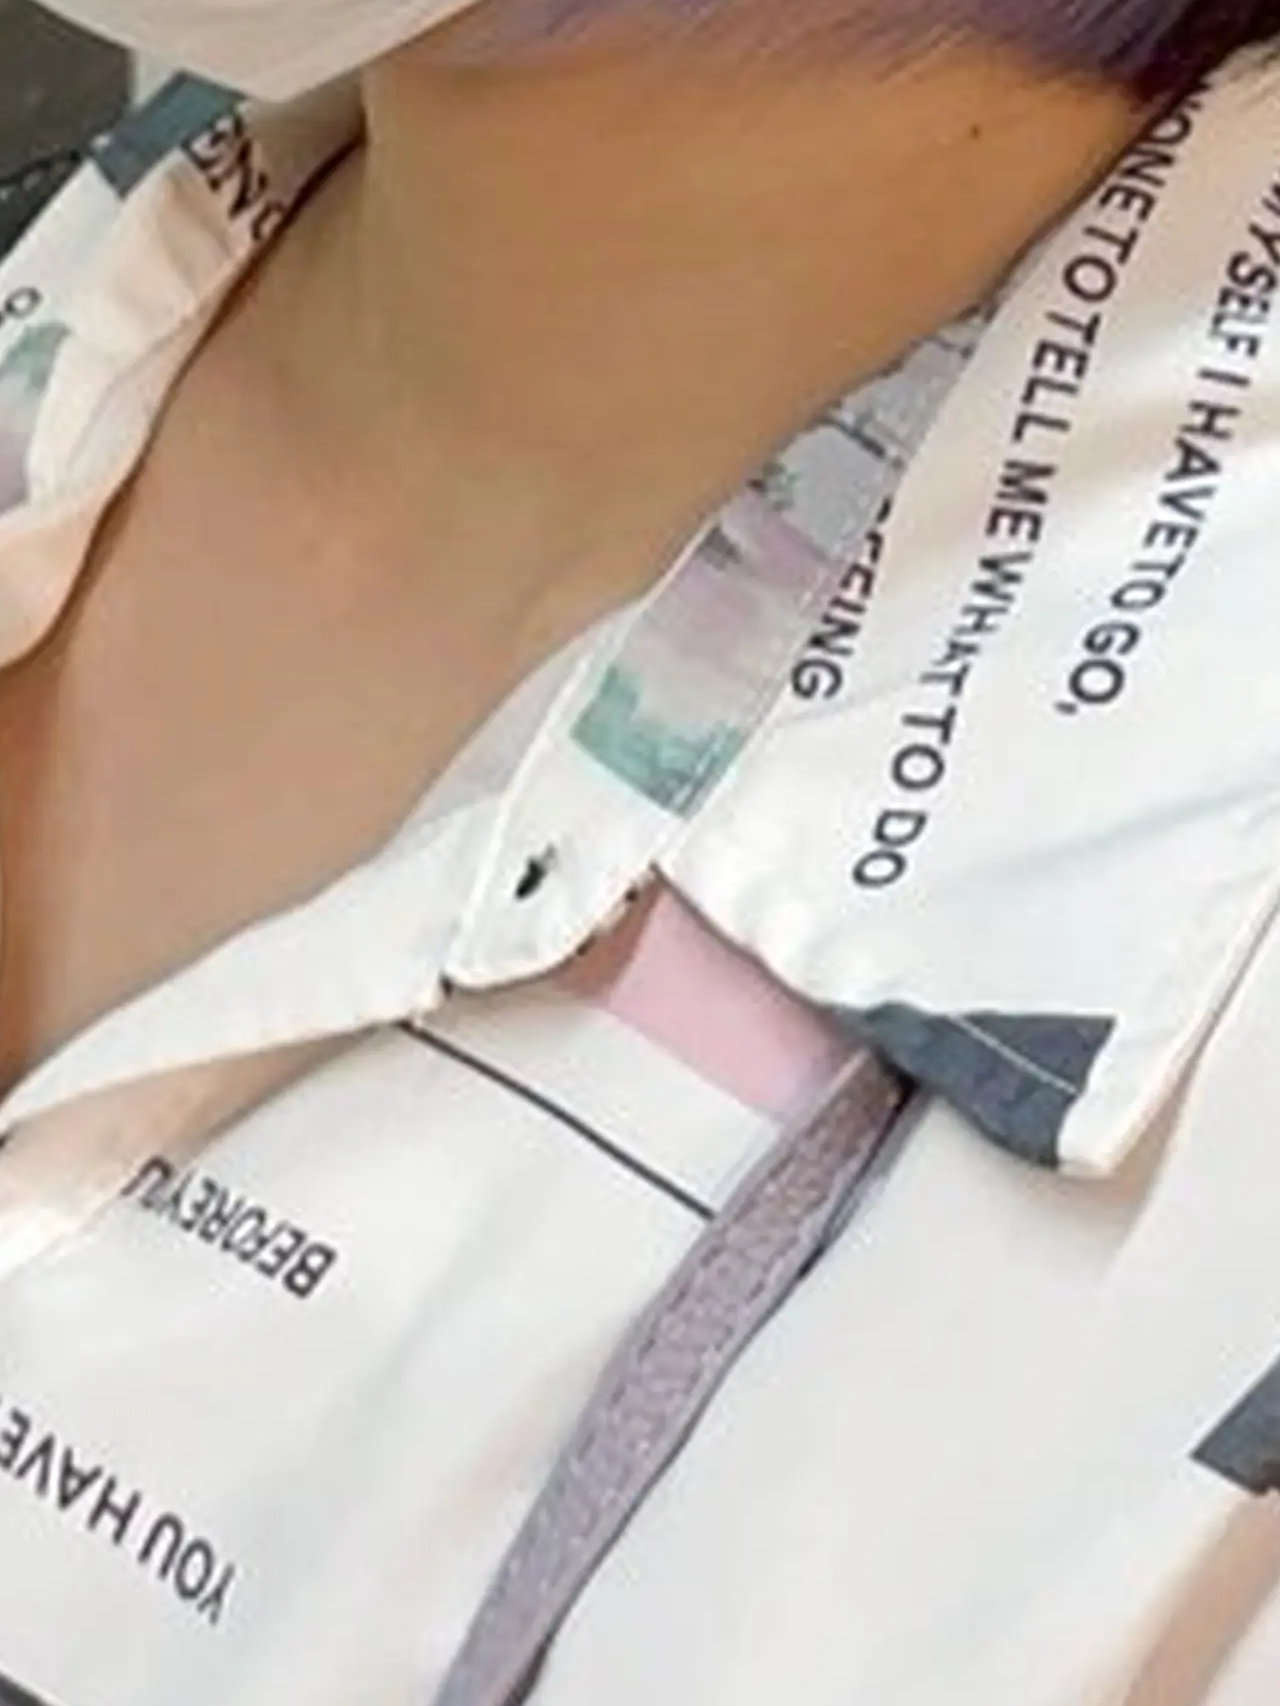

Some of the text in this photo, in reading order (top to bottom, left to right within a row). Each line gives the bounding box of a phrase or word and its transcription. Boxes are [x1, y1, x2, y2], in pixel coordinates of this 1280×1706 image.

[1053, 619, 1142, 717] GO,
[852, 808, 929, 889] DO
[136, 1513, 236, 1625] YOU
